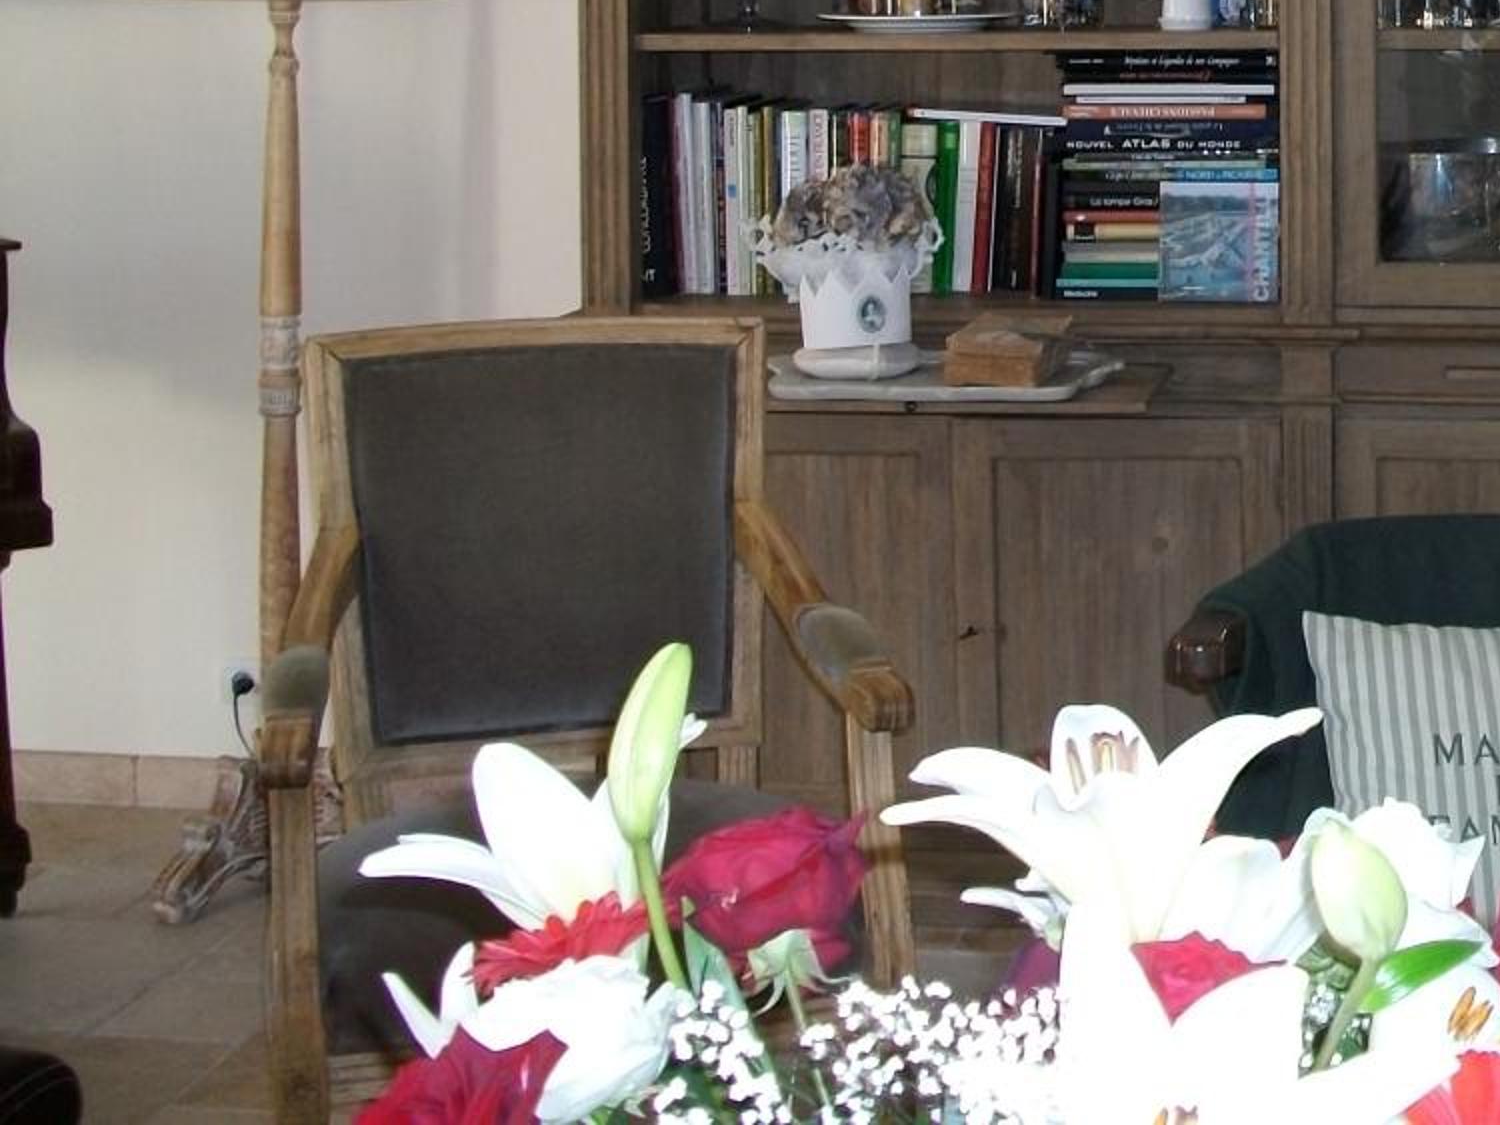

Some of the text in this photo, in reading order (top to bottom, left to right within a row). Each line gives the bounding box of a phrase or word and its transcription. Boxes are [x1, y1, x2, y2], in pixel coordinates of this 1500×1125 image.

[1066, 138, 1241, 150] NOUVEL ATLAS DU MONDE
